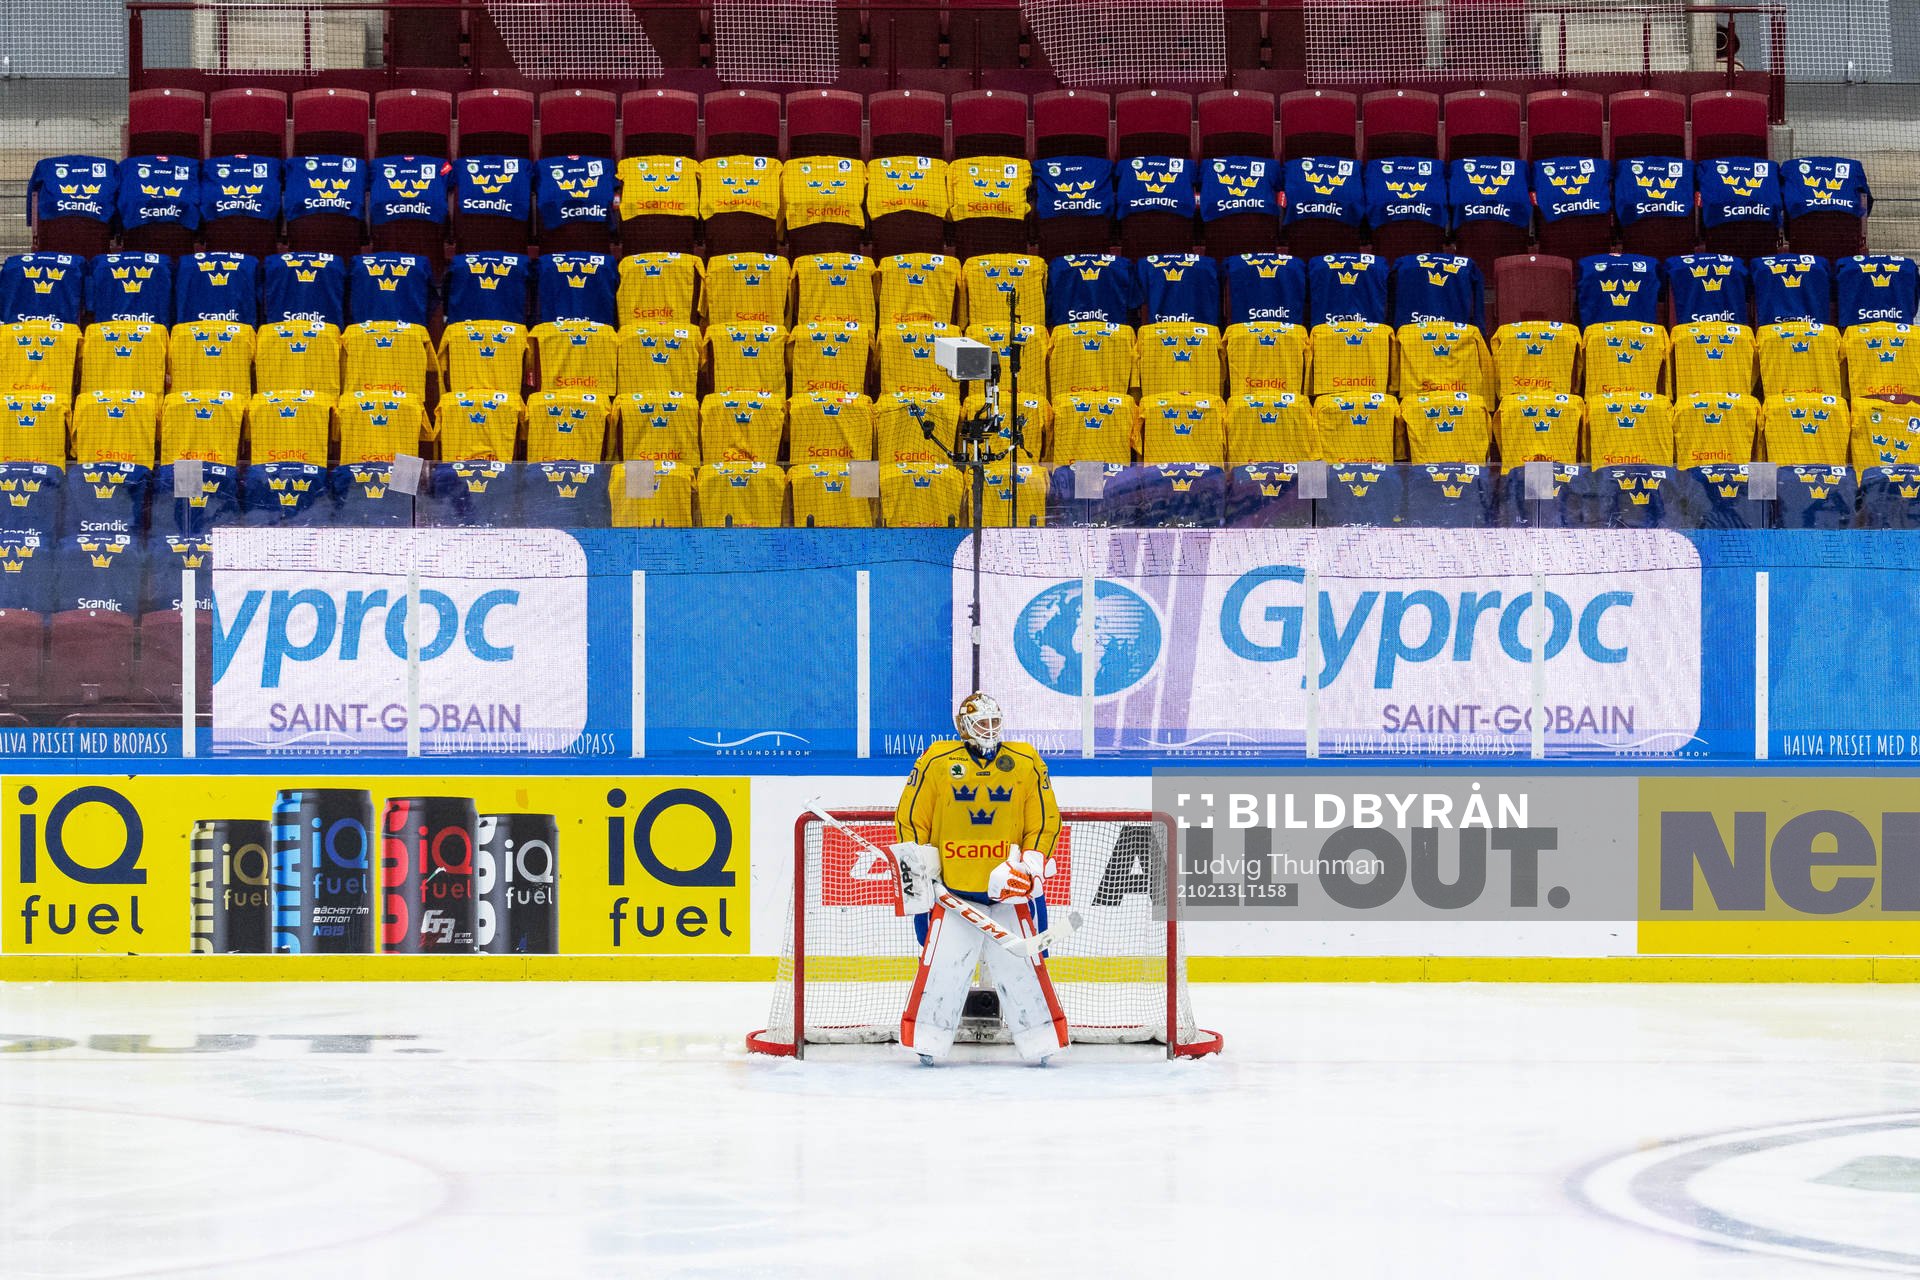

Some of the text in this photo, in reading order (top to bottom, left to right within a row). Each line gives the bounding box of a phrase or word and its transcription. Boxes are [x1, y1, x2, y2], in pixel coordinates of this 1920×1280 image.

[57, 200, 103, 215] Scandic
[216, 199, 262, 212] Scandic
[304, 197, 352, 210] Scandic
[385, 202, 431, 215] Scandic
[463, 198, 513, 212] Scandic
[968, 201, 1014, 213] Scandic
[1054, 198, 1102, 210] Scandic
[1217, 199, 1265, 211] Scandic
[1296, 203, 1343, 216] Scandic
[1386, 204, 1432, 216] Scandic
[1464, 203, 1511, 217] Scandic
[1552, 199, 1600, 214] Scandic
[1636, 201, 1685, 213] Scandic
[1723, 204, 1770, 216] Scandic
[139, 205, 182, 218] Scandic
[561, 205, 607, 218] Scandic
[807, 206, 850, 218] Scandic
[198, 309, 240, 322] Scandic
[283, 311, 325, 322] Scandic
[1068, 310, 1108, 322] Scandic
[1248, 307, 1290, 319] Scandic
[1691, 310, 1735, 322] Scandic
[1859, 308, 1902, 319] Scandic
[1332, 376, 1376, 387] Scandic
[808, 446, 854, 458] Scandic
[80, 520, 128, 532] Scandic
[77, 598, 122, 612] Scandic
[1220, 564, 1633, 690] Gyproc
[269, 703, 521, 734] SAINT-GOBAIN
[1382, 703, 1635, 735] SAINT-GOBAIN
[33, 732, 75, 754] PRISET
[80, 732, 107, 754] MED
[113, 732, 168, 754] BROPASS
[434, 733, 615, 755] HALVA PRISET MED BROPASS
[885, 734, 924, 755] HALVA
[1335, 734, 1516, 756] HALVA PRISET MED BROPASS
[1784, 735, 1823, 756] HALVA
[1830, 735, 1871, 756] PRISET
[1877, 735, 1905, 756] MED
[18, 786, 147, 885] iQ
[606, 788, 736, 887] iQ
[312, 817, 369, 869] iQ
[945, 840, 1012, 859] Scandi
[419, 826, 473, 875] iQ
[222, 843, 269, 885] iQ
[504, 839, 553, 883] iQ
[1318, 825, 1571, 910] OUT.
[313, 873, 367, 899] fuel
[420, 879, 472, 903] fuel
[224, 889, 268, 910] fuel
[505, 887, 553, 908] fuel
[21, 895, 144, 944] fuel
[609, 898, 732, 947] fuel
[938, 892, 1008, 940] CCM
